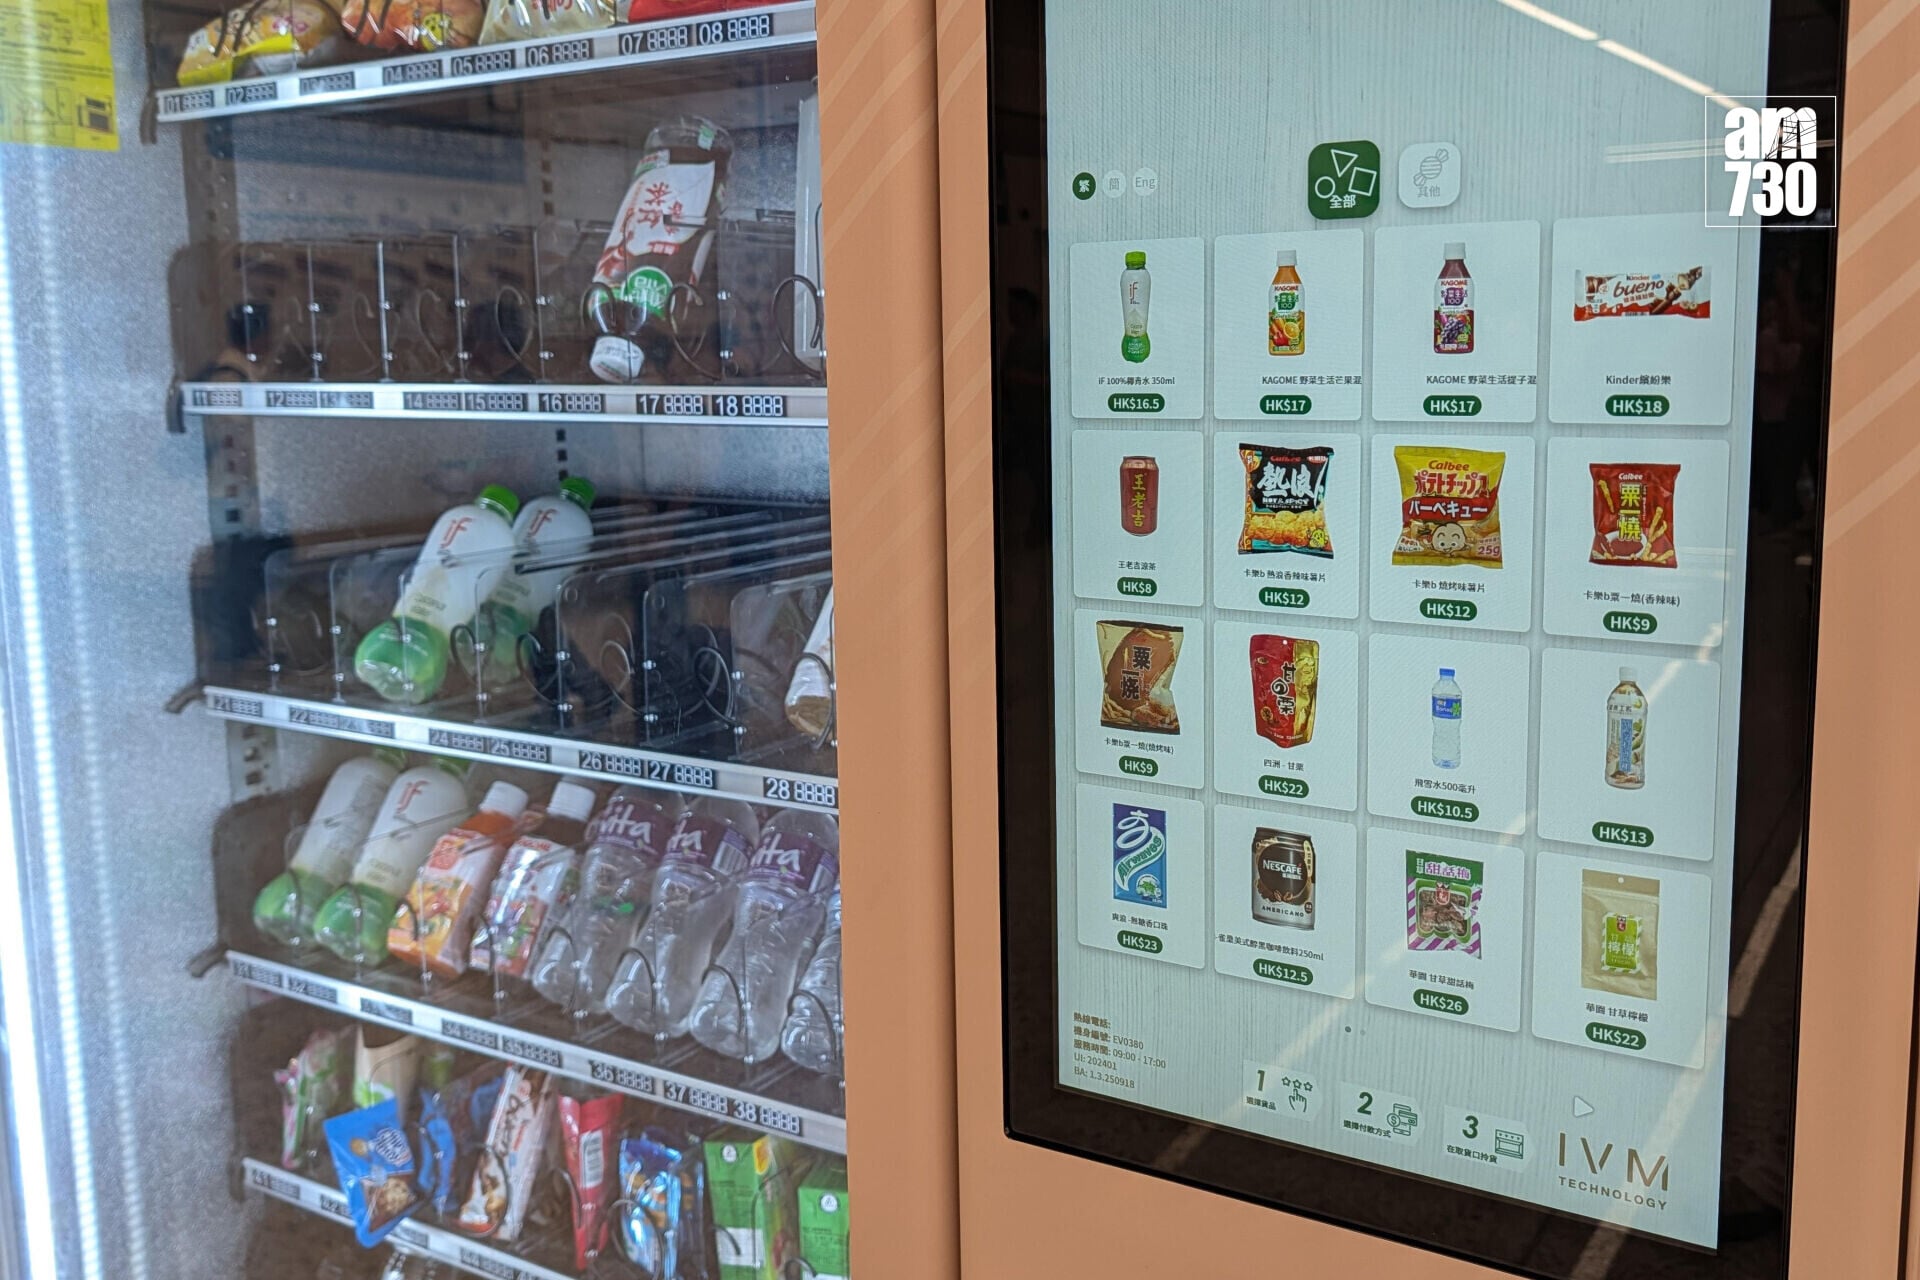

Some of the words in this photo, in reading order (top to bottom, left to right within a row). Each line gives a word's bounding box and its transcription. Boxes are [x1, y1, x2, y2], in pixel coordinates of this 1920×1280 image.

[701, 25, 723, 44] 08
[621, 35, 642, 54] 07
[453, 57, 473, 75] 05
[527, 48, 549, 67] 06
[384, 64, 405, 83] 04
[167, 94, 181, 112] 01
[227, 87, 244, 105] 02
[1078, 179, 1090, 192] 繁
[1135, 176, 1156, 190] Eng
[1417, 185, 1441, 198] 其他
[1329, 194, 1356, 209] 全部
[1613, 279, 1665, 298] bueno
[1151, 376, 1175, 385] 350ml
[1262, 375, 1298, 385] KAGOME
[1426, 375, 1466, 384] KAGOME
[1605, 375, 1671, 385] Kinder繽紛樂
[268, 391, 284, 407] 12
[407, 393, 423, 409] 14
[469, 394, 486, 411] 15
[541, 394, 562, 412] 16
[639, 396, 660, 414] 17
[716, 396, 739, 415] 18
[1113, 397, 1160, 411] HK$16.5
[1265, 398, 1306, 412] HK$17
[1430, 399, 1475, 414] HK$17
[1612, 399, 1662, 414] HK$18
[1428, 460, 1470, 471] Calbee
[1257, 461, 1315, 498] 熱浪
[1414, 470, 1489, 497] ポテトチップス
[1618, 472, 1643, 481] Calbee
[1132, 474, 1146, 527] 王老吉
[1409, 501, 1488, 518] バーベキュー
[1478, 545, 1500, 556] 25g
[1118, 561, 1156, 571] 王老吉涼茶
[1122, 581, 1152, 594] HK$8
[1439, 581, 1485, 593] 燒烤味薯片
[1264, 591, 1304, 605] HK$12
[1426, 603, 1471, 618] HK$12
[1610, 616, 1650, 632] HK$9
[292, 707, 308, 723] 22
[431, 729, 449, 746] 24
[491, 736, 509, 755] 25
[582, 751, 602, 771] 26
[1124, 760, 1153, 774] HK$9
[1263, 759, 1281, 769] 四洲
[1288, 761, 1304, 772] 甘栗
[650, 761, 670, 782] 27
[766, 777, 790, 799] 28
[1264, 779, 1304, 795] HK$22
[1414, 778, 1476, 794] 飛雪水500毫升
[1417, 800, 1473, 819] HK$10.5
[1600, 826, 1648, 844] HK$13
[1118, 835, 1163, 887] Airwaves
[1112, 912, 1127, 923] 爽浪
[1262, 905, 1304, 917] AMERICANO
[1122, 934, 1158, 951] HK$23
[1258, 962, 1308, 983] HK$12.5
[1429, 973, 1474, 990] 甘草甜話梅
[1420, 993, 1463, 1012] HK$26
[1608, 1006, 1649, 1023] 甘草檸檬
[1113, 1035, 1144, 1050] EV0380
[1592, 1027, 1640, 1047] HK$22
[1074, 1052, 1086, 1062] UI:
[1087, 1056, 1117, 1071] 202401
[1112, 1049, 1136, 1062] 09:00
[1143, 1056, 1166, 1069] 17:00
[594, 1063, 614, 1082] 36
[1074, 1066, 1088, 1077] BA:
[1090, 1071, 1135, 1088] 1.3.250918
[1257, 1070, 1266, 1091] 1
[666, 1080, 686, 1101] 37
[734, 1099, 757, 1122] 38
[1357, 1092, 1373, 1115] 2
[1343, 1119, 1392, 1138] 選擇付款方式
[1462, 1115, 1479, 1139] 3
[1558, 1132, 1669, 1191] IVM
[1558, 1175, 1667, 1210] TECHNOLOGY
